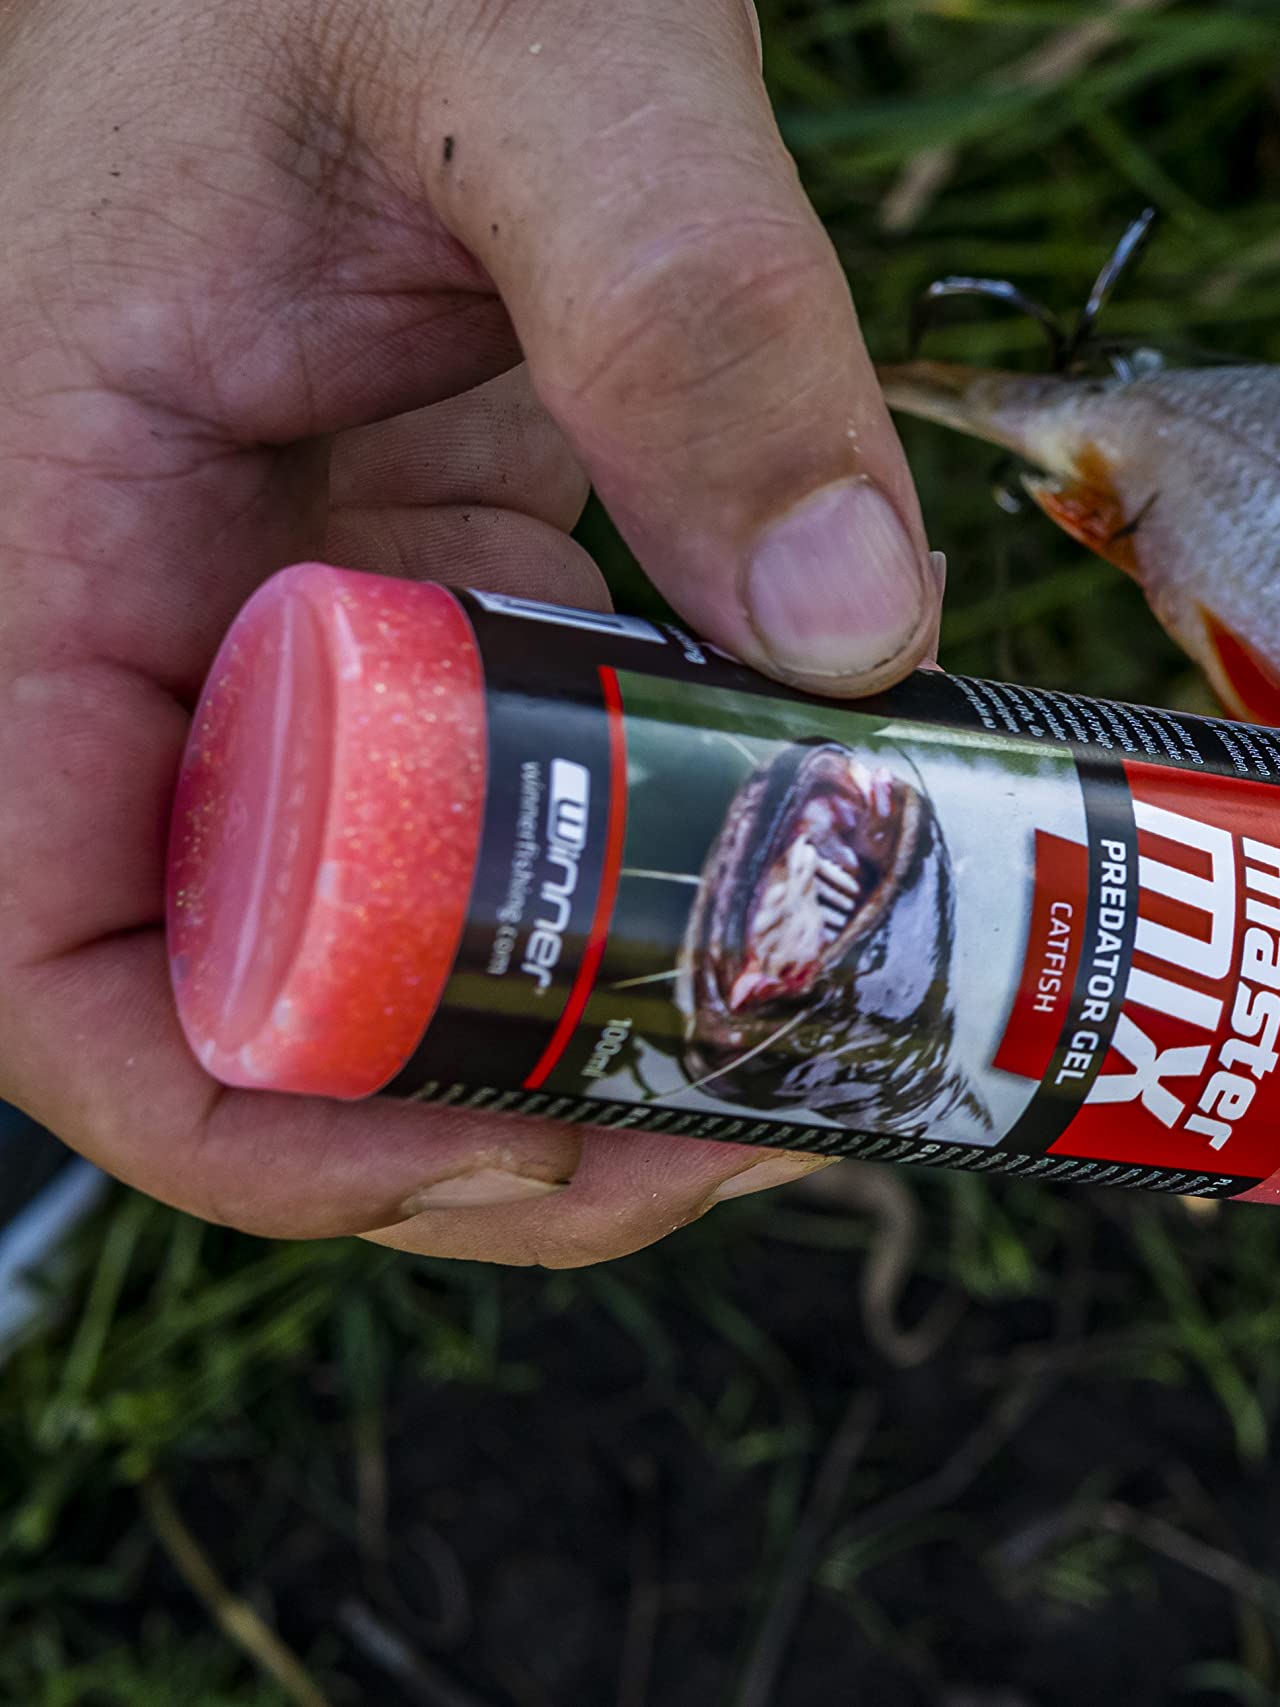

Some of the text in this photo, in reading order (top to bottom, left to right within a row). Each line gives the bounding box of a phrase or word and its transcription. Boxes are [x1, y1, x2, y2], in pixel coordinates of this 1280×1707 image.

[1184, 748, 1205, 766] pro
[1254, 760, 1272, 777] von
[1033, 901, 1073, 1013] CATFISH
[1054, 838, 1127, 1086] PREDATOR GEL
[581, 1017, 633, 1078] 100ml
